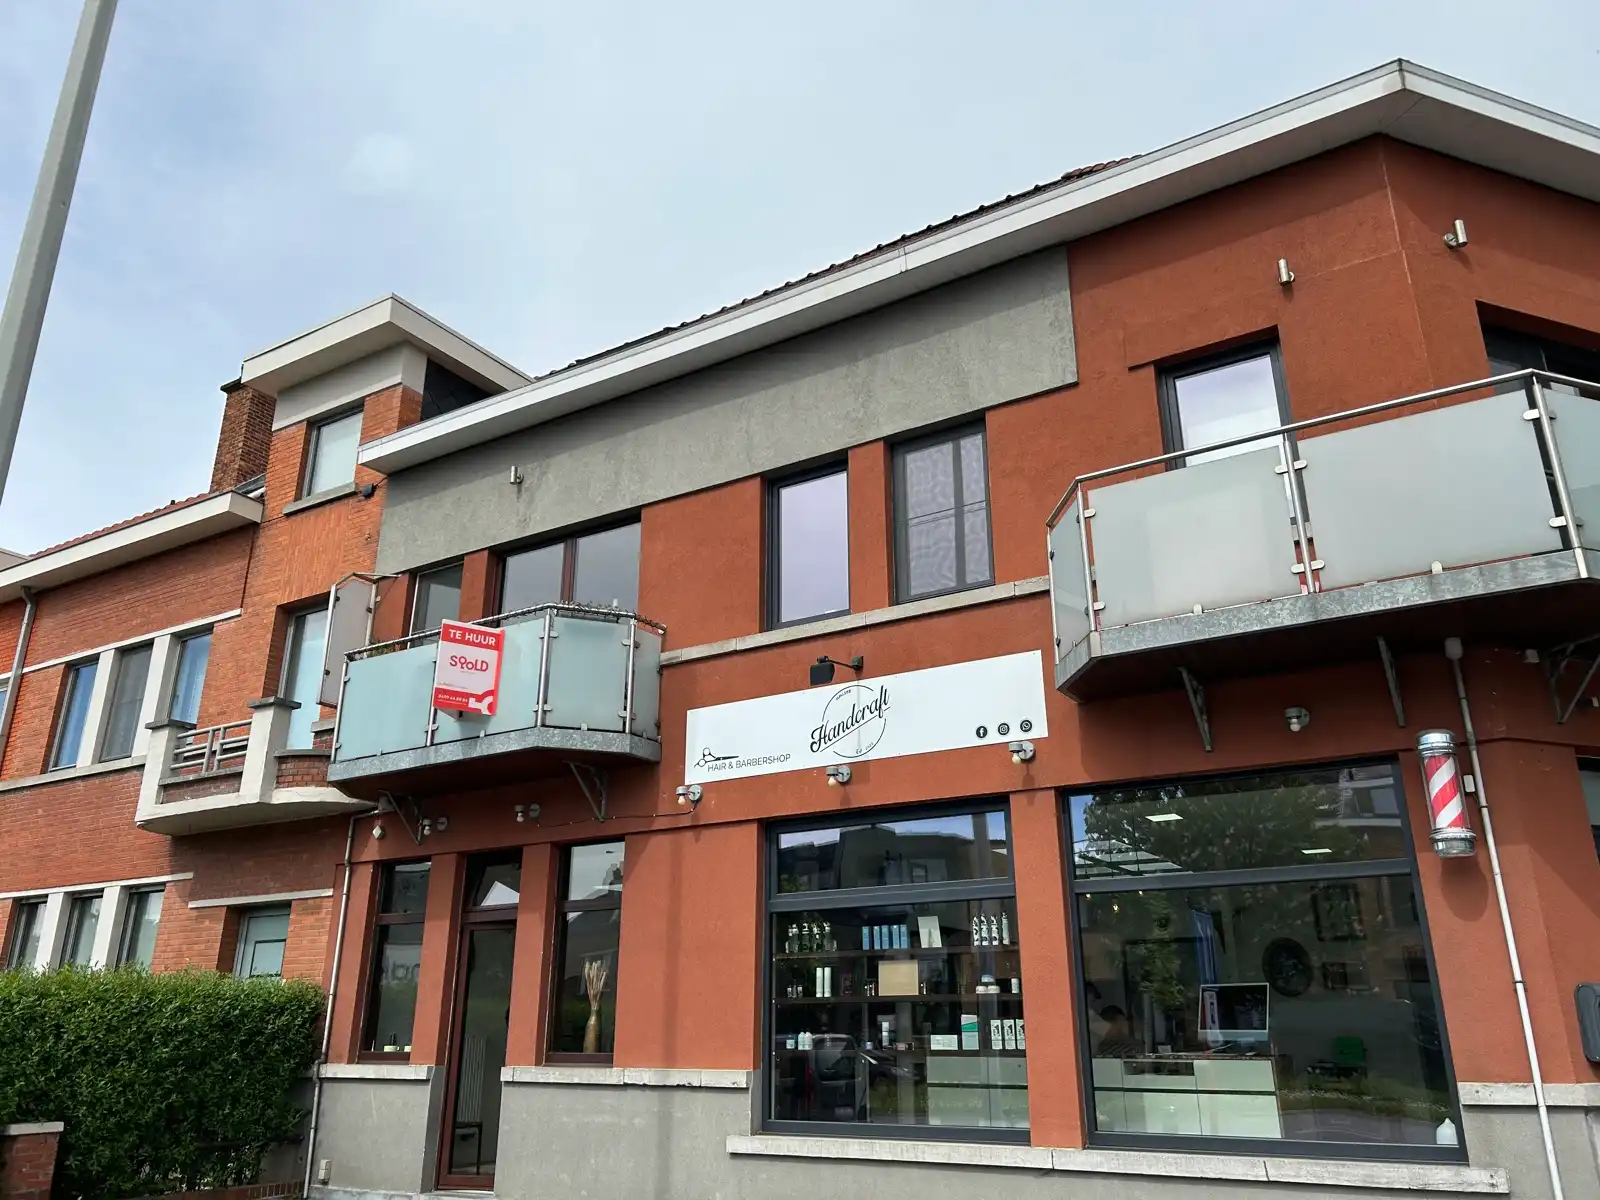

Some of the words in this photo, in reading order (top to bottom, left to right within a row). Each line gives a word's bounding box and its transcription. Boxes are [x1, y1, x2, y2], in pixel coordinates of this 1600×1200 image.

[448, 629, 462, 640] TE
[465, 632, 496, 646] HUUR
[810, 685, 890, 753] Handcraft
[707, 762, 726, 772] HAIR
[728, 761, 734, 769] &
[735, 753, 791, 769] BARBERSHOP
